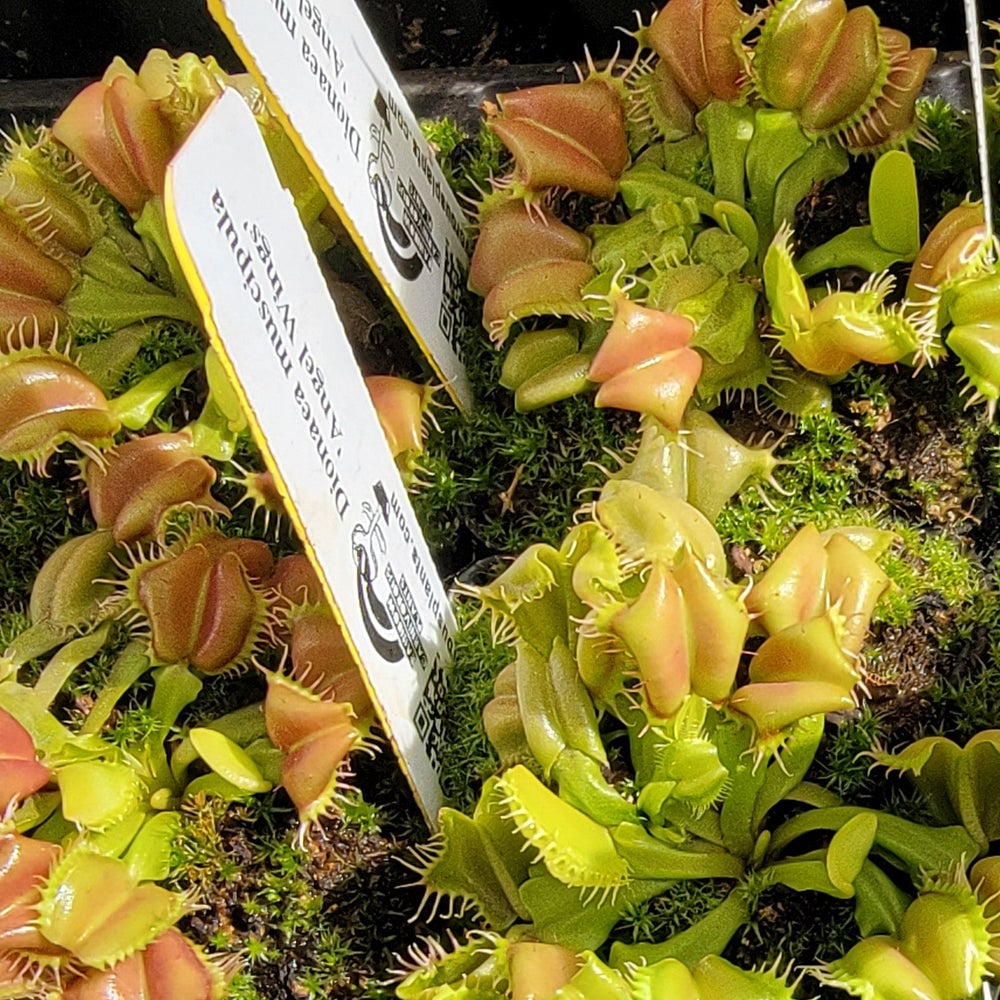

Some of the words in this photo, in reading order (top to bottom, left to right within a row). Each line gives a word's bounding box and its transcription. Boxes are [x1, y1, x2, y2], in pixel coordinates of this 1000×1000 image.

[302, 36, 361, 162] Dionaea
[211, 186, 294, 379] muscipula
[243, 220, 297, 346] Wings'
[295, 380, 350, 522] Dionaea
[299, 342, 343, 457] 'Angel
